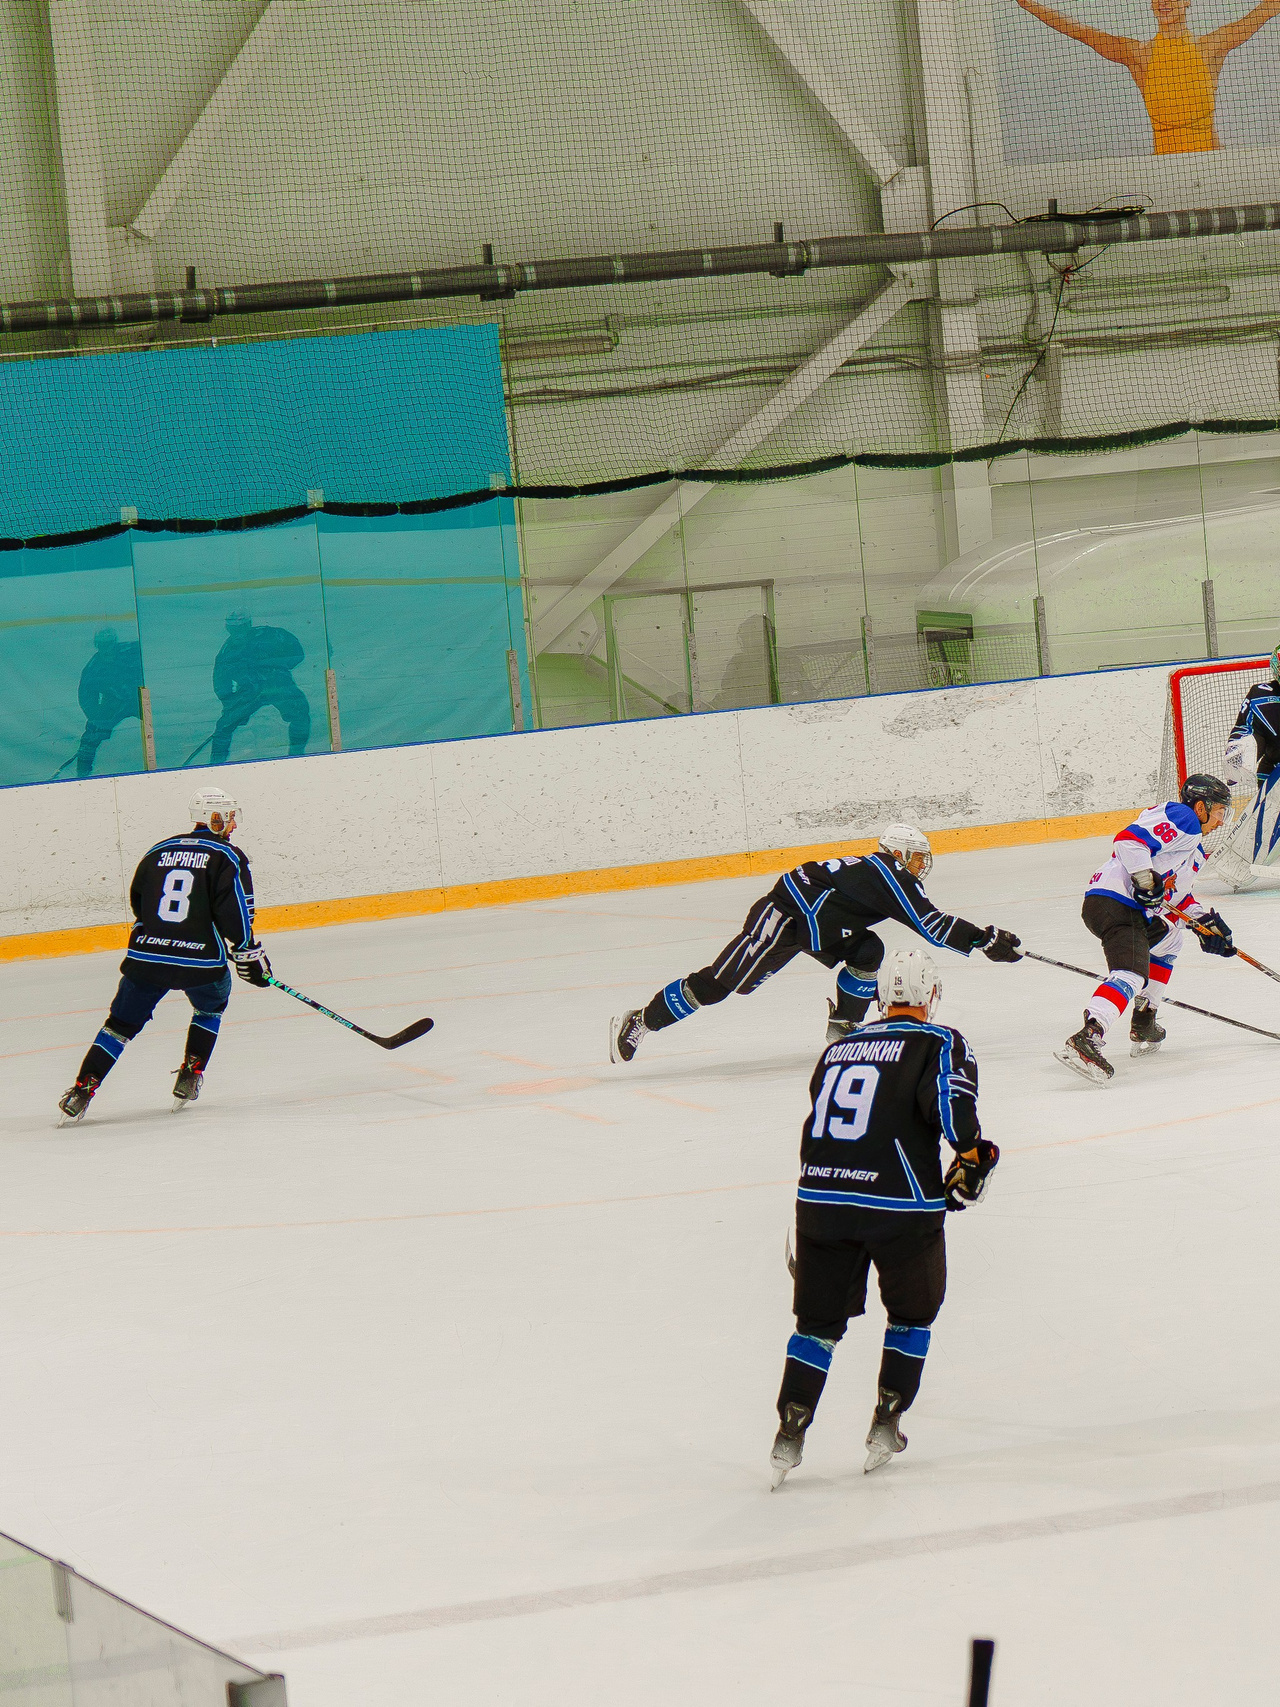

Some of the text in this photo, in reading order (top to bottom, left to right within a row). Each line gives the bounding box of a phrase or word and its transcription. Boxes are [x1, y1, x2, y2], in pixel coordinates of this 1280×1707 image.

[1153, 822, 1178, 844] 66
[1226, 812, 1248, 841] TRUE
[157, 869, 194, 923] 8
[146, 936, 206, 950] ONE TIMER
[894, 976, 903, 985] 19
[811, 1065, 881, 1141] 19
[807, 1165, 879, 1182] ONE TIMER
